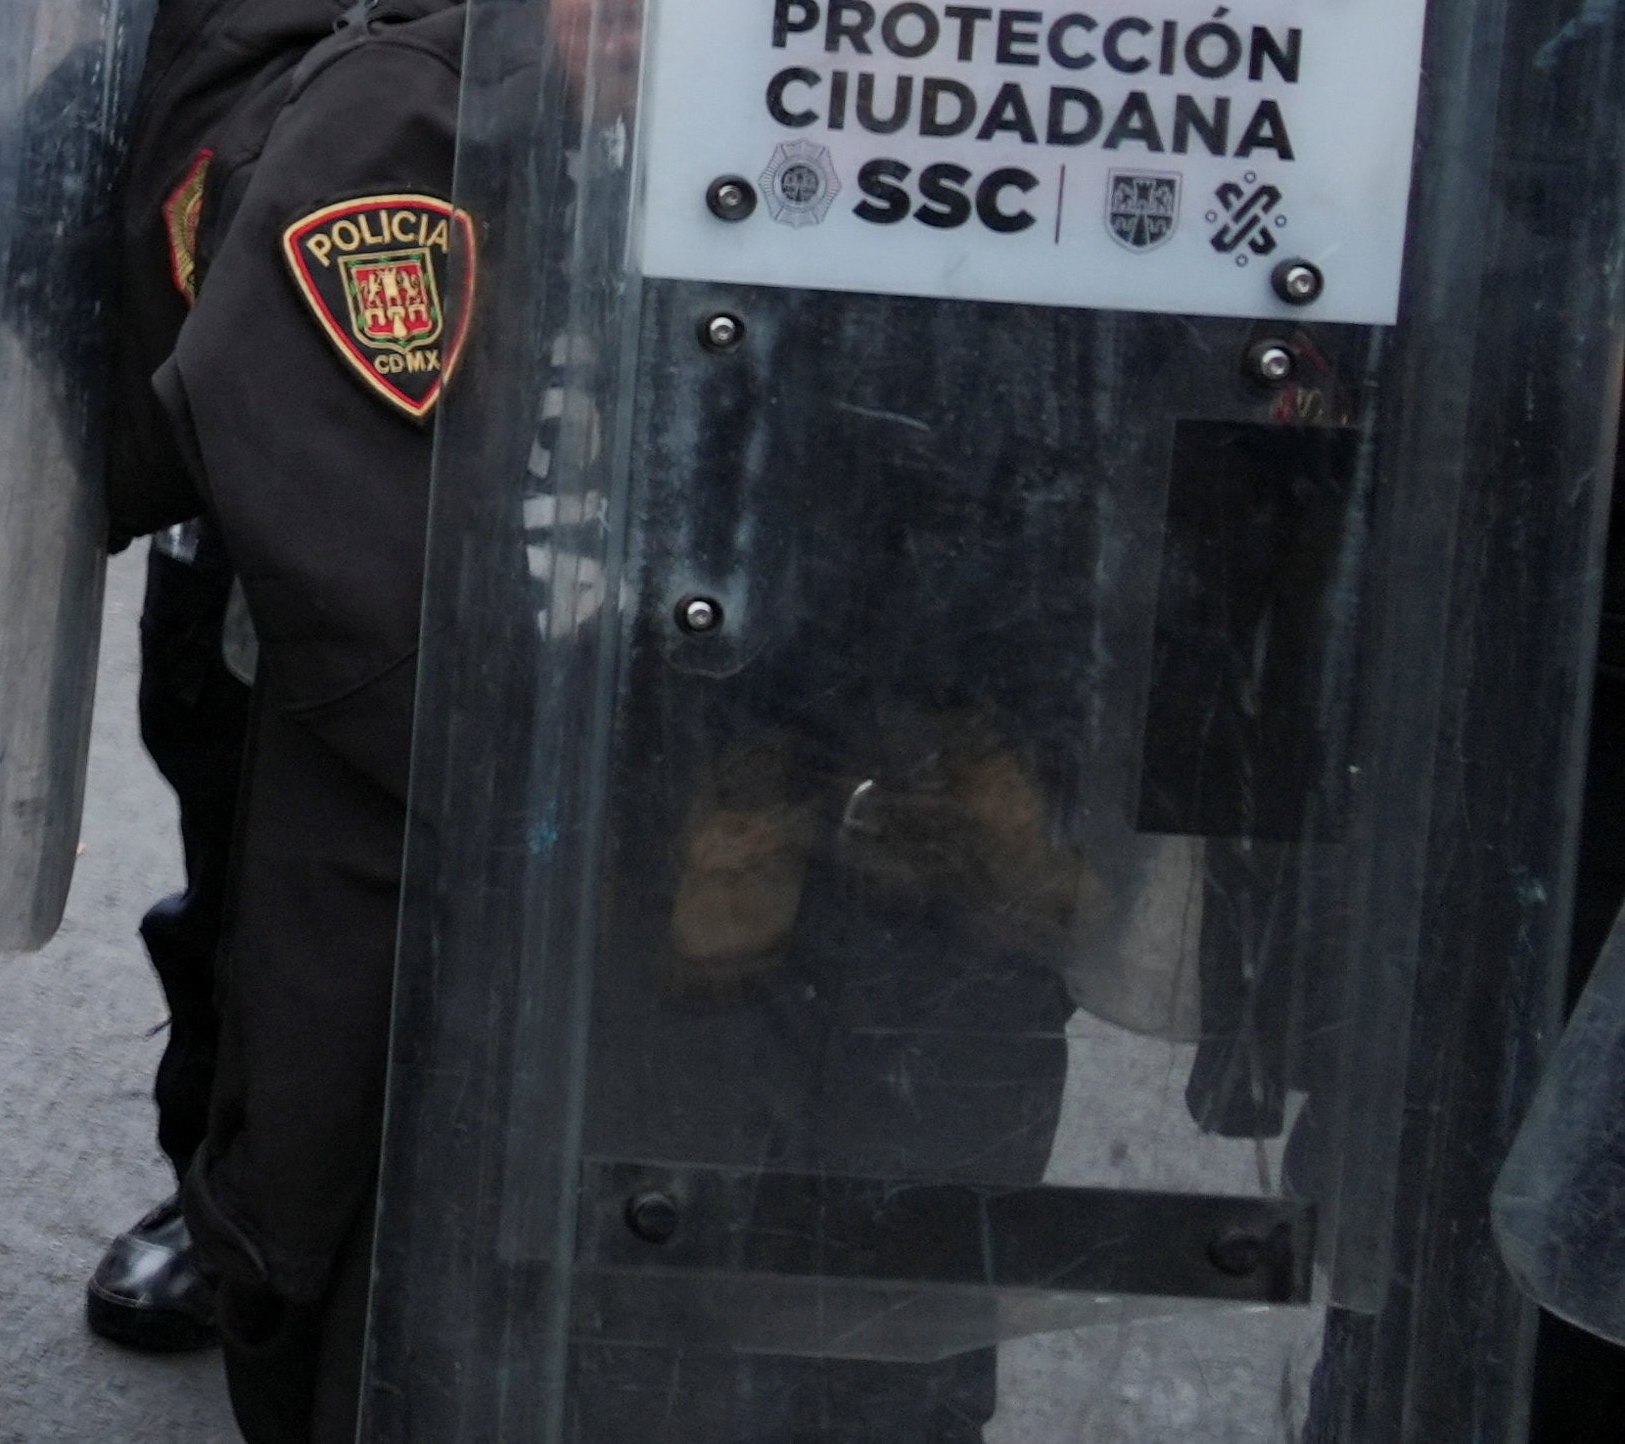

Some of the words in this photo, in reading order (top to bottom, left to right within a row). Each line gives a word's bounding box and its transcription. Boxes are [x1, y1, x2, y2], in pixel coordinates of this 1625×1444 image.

[766, 65, 1297, 161] CIUDADANA
[853, 159, 1040, 233] SSC
[306, 209, 450, 268] POLICIA
[373, 349, 441, 375] CDMX
